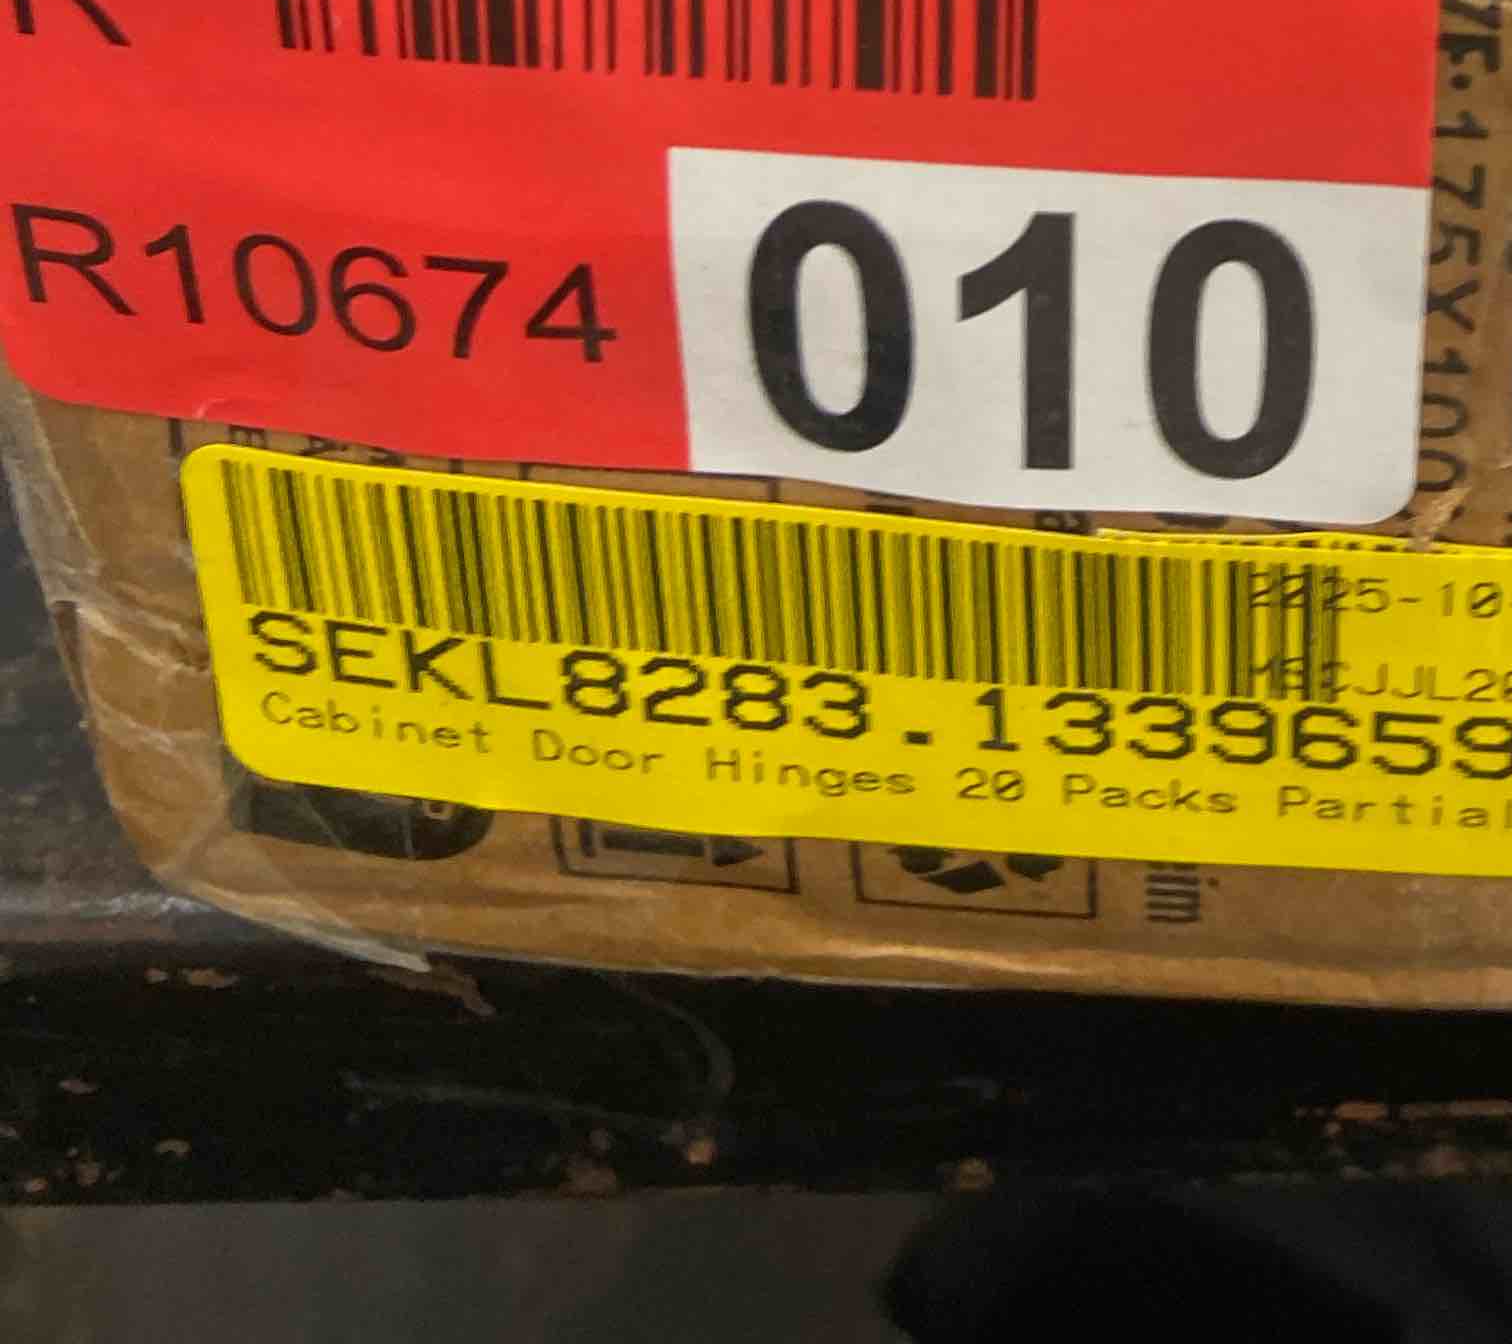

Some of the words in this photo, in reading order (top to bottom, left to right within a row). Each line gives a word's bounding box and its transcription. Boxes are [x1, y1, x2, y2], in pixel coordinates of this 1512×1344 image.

[12, 203, 617, 362] R10674
[748, 200, 1316, 480] 010
[261, 690, 489, 753] Cabinet
[533, 729, 664, 774] Door
[706, 748, 916, 797] Hinges
[957, 767, 1025, 802] 20
[1062, 773, 1237, 814] Packs
